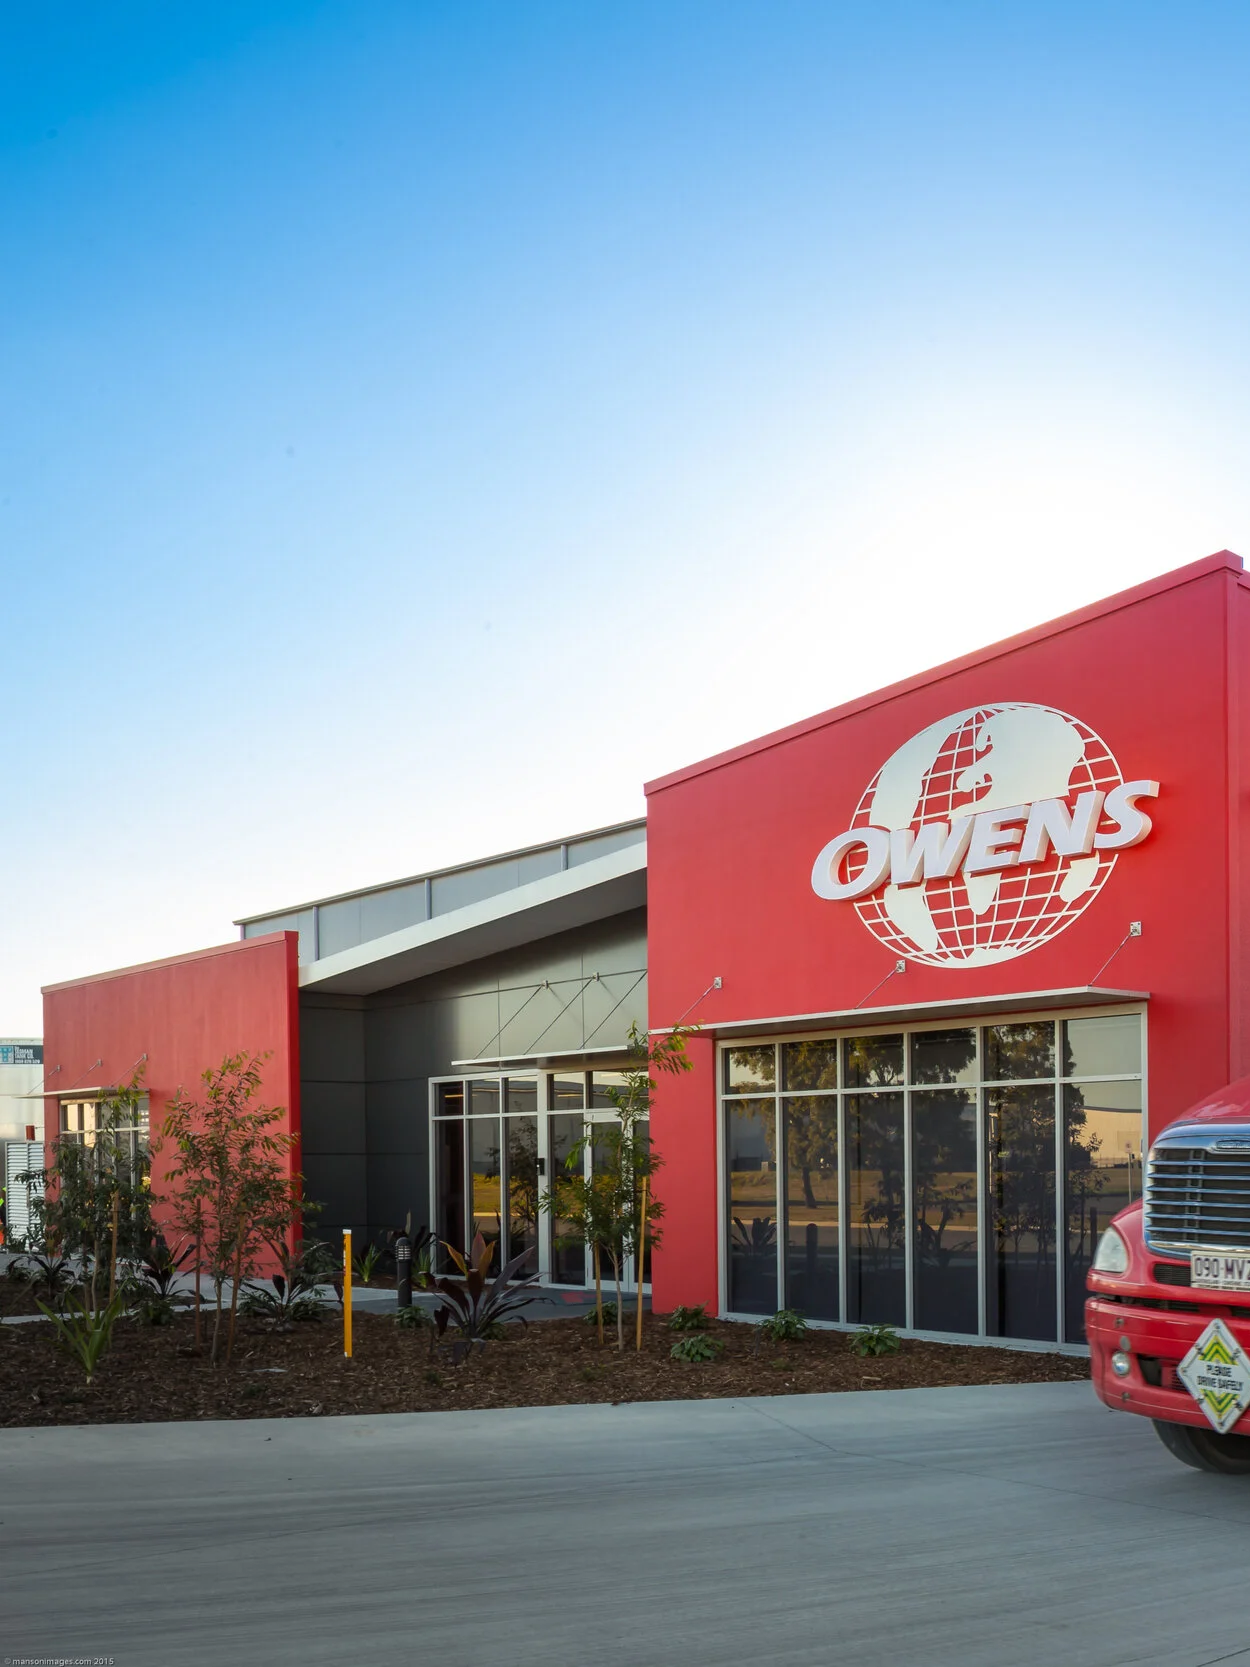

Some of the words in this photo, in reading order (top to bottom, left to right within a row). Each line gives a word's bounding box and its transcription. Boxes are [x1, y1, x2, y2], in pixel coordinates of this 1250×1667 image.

[811, 780, 1160, 901] OWENS
[1206, 1365, 1231, 1377] PLEASE
[1197, 1375, 1217, 1389] DRIVE
[1218, 1378, 1244, 1392] SAFELY
